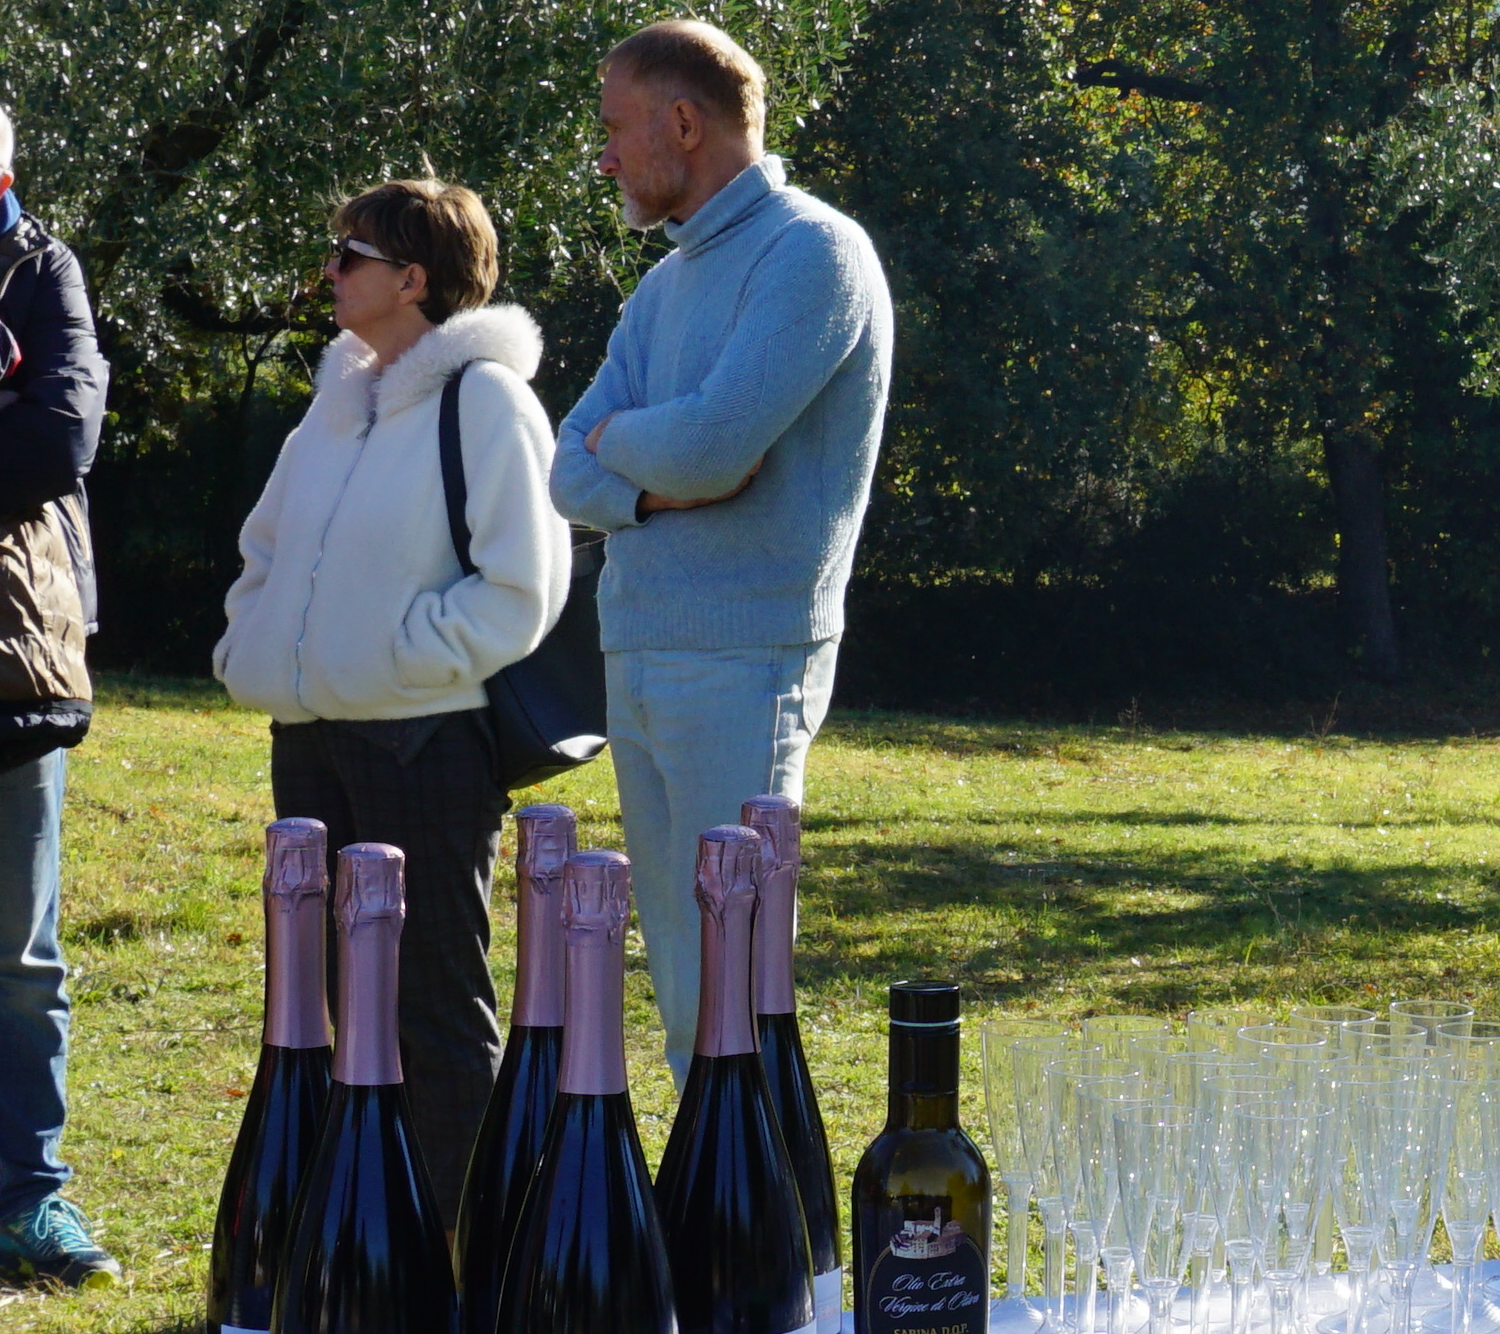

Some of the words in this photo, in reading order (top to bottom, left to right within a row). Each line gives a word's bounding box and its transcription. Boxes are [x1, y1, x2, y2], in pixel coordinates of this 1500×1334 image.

[891, 1273, 924, 1292] Olio
[927, 1270, 967, 1290] Extra
[879, 1295, 929, 1319] Vergine
[930, 1298, 946, 1312] di
